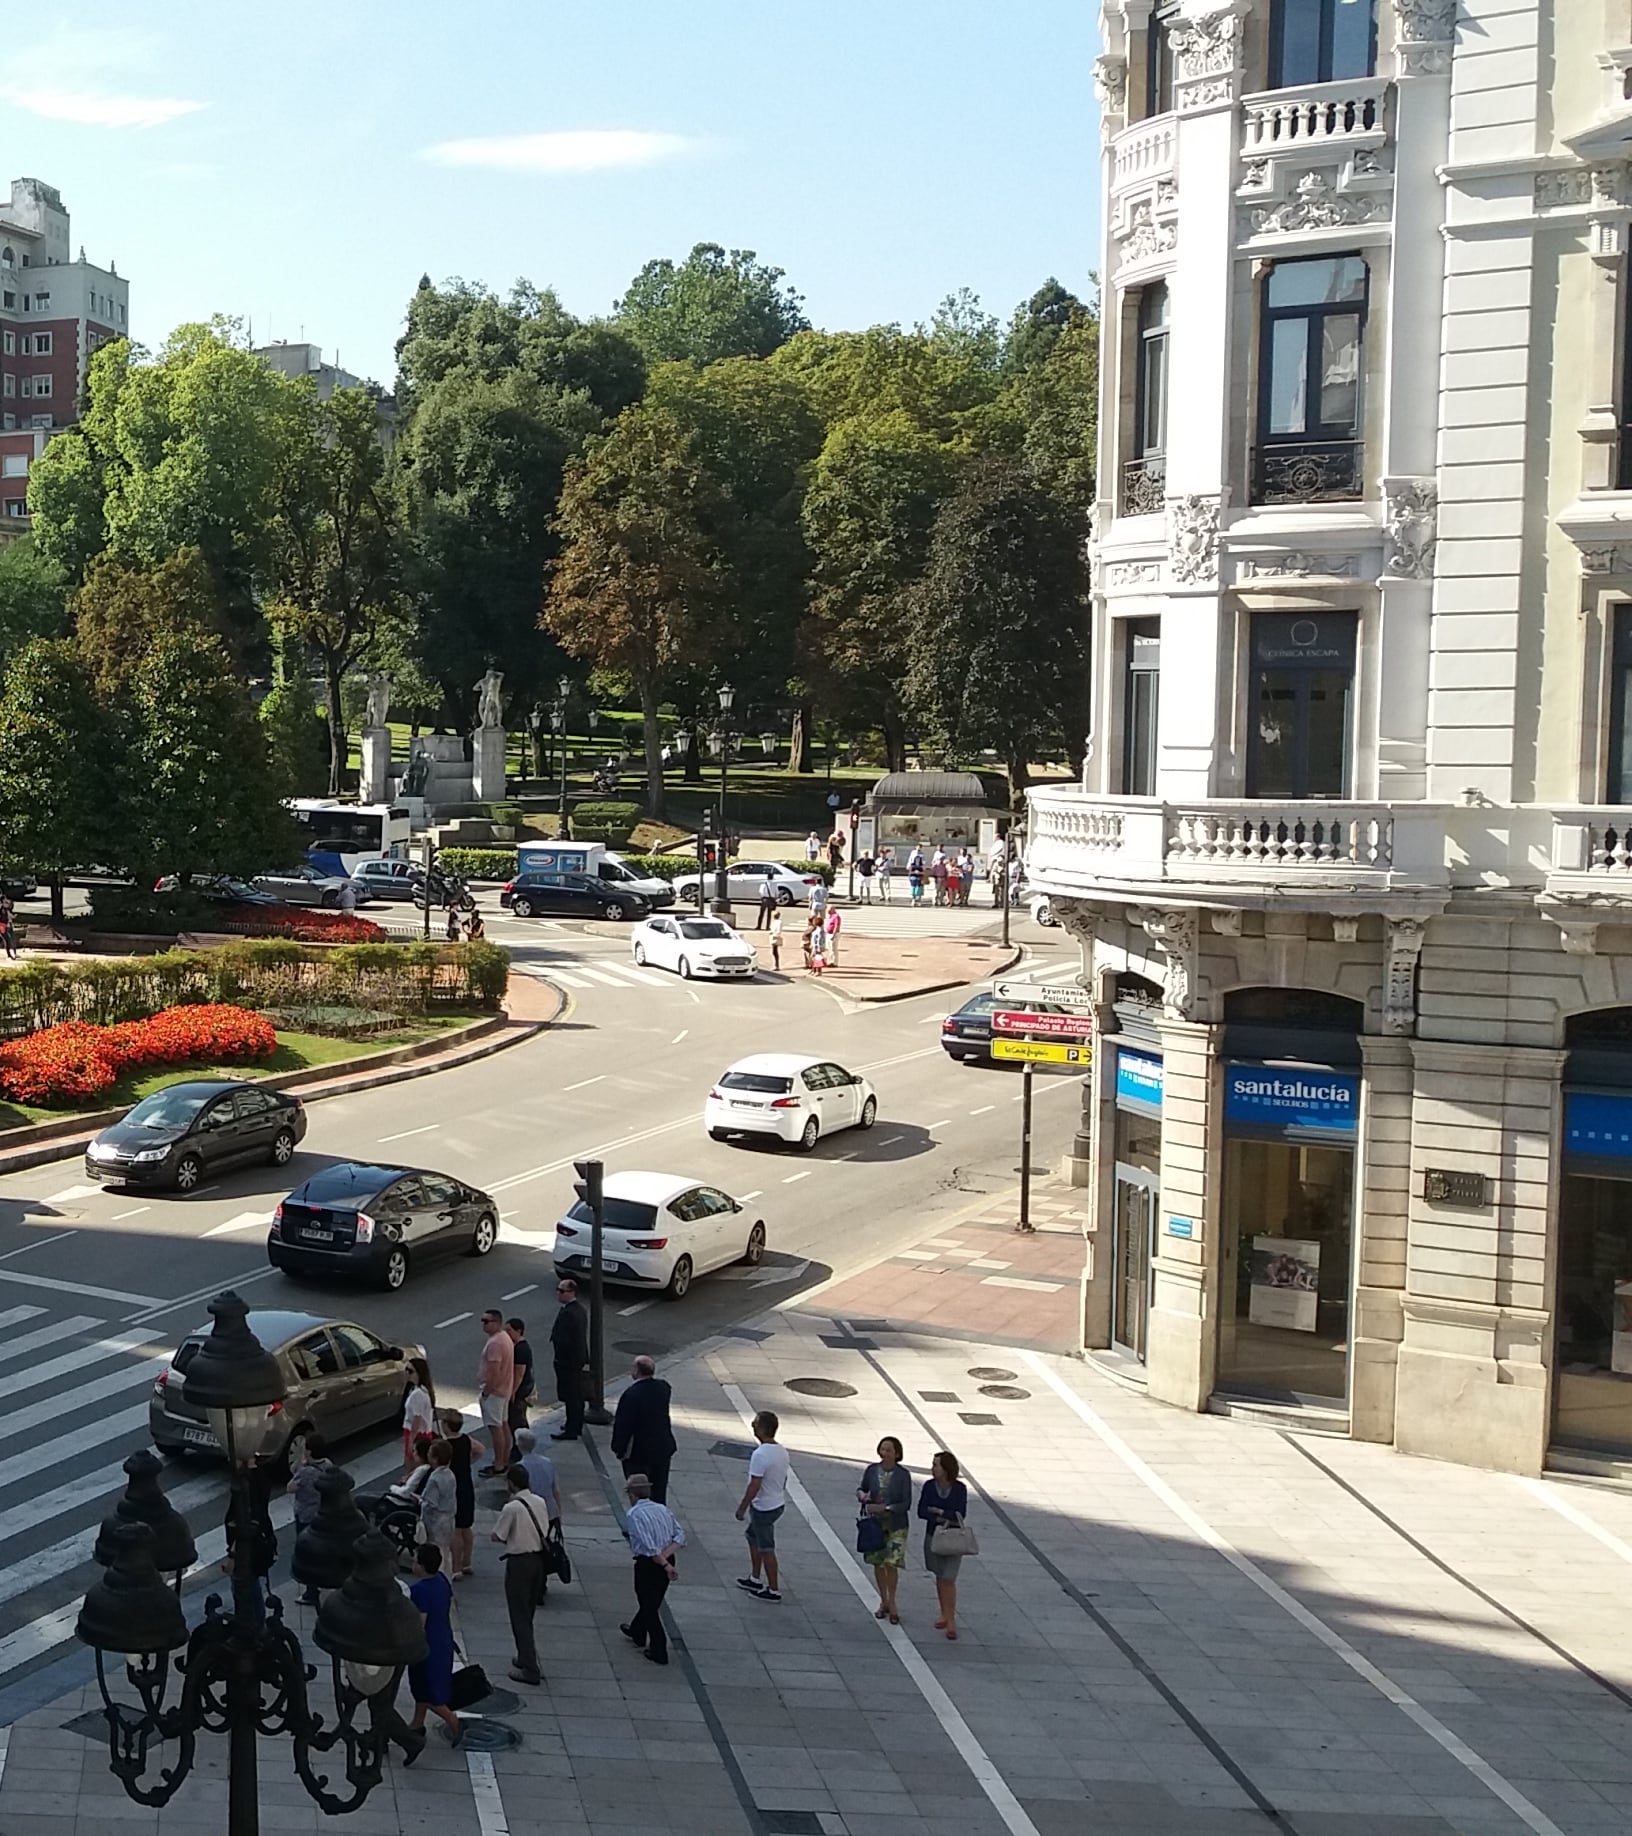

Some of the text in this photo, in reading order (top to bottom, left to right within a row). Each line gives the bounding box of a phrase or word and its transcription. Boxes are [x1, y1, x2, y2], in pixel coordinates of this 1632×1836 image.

[1010, 1021, 1050, 1031] PRINCIPADO
[1051, 1023, 1061, 1032] DE
[1234, 1080, 1350, 1102] santalucía
